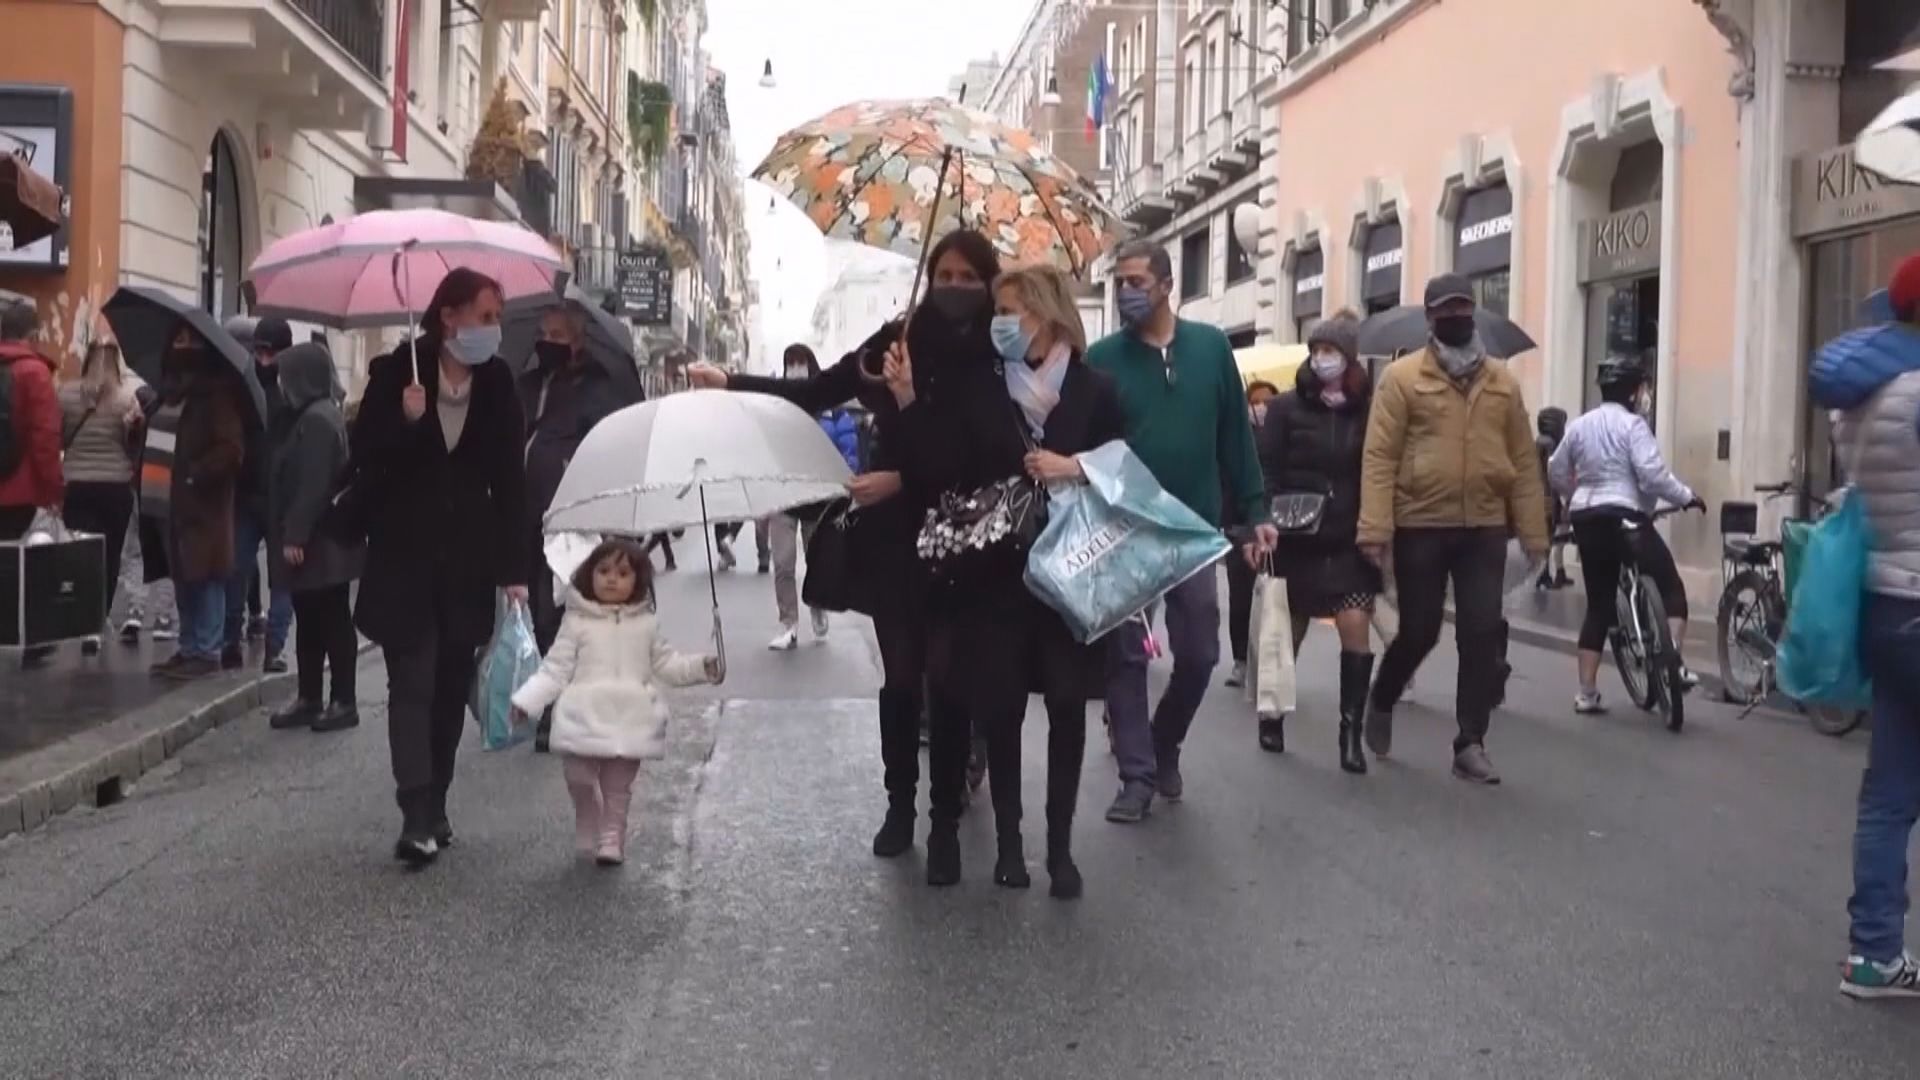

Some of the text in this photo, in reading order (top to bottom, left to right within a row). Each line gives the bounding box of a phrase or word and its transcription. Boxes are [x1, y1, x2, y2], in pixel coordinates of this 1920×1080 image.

[1817, 150, 1888, 201] KIK
[1595, 210, 1650, 256] KIKO
[621, 256, 656, 267] OUTLET
